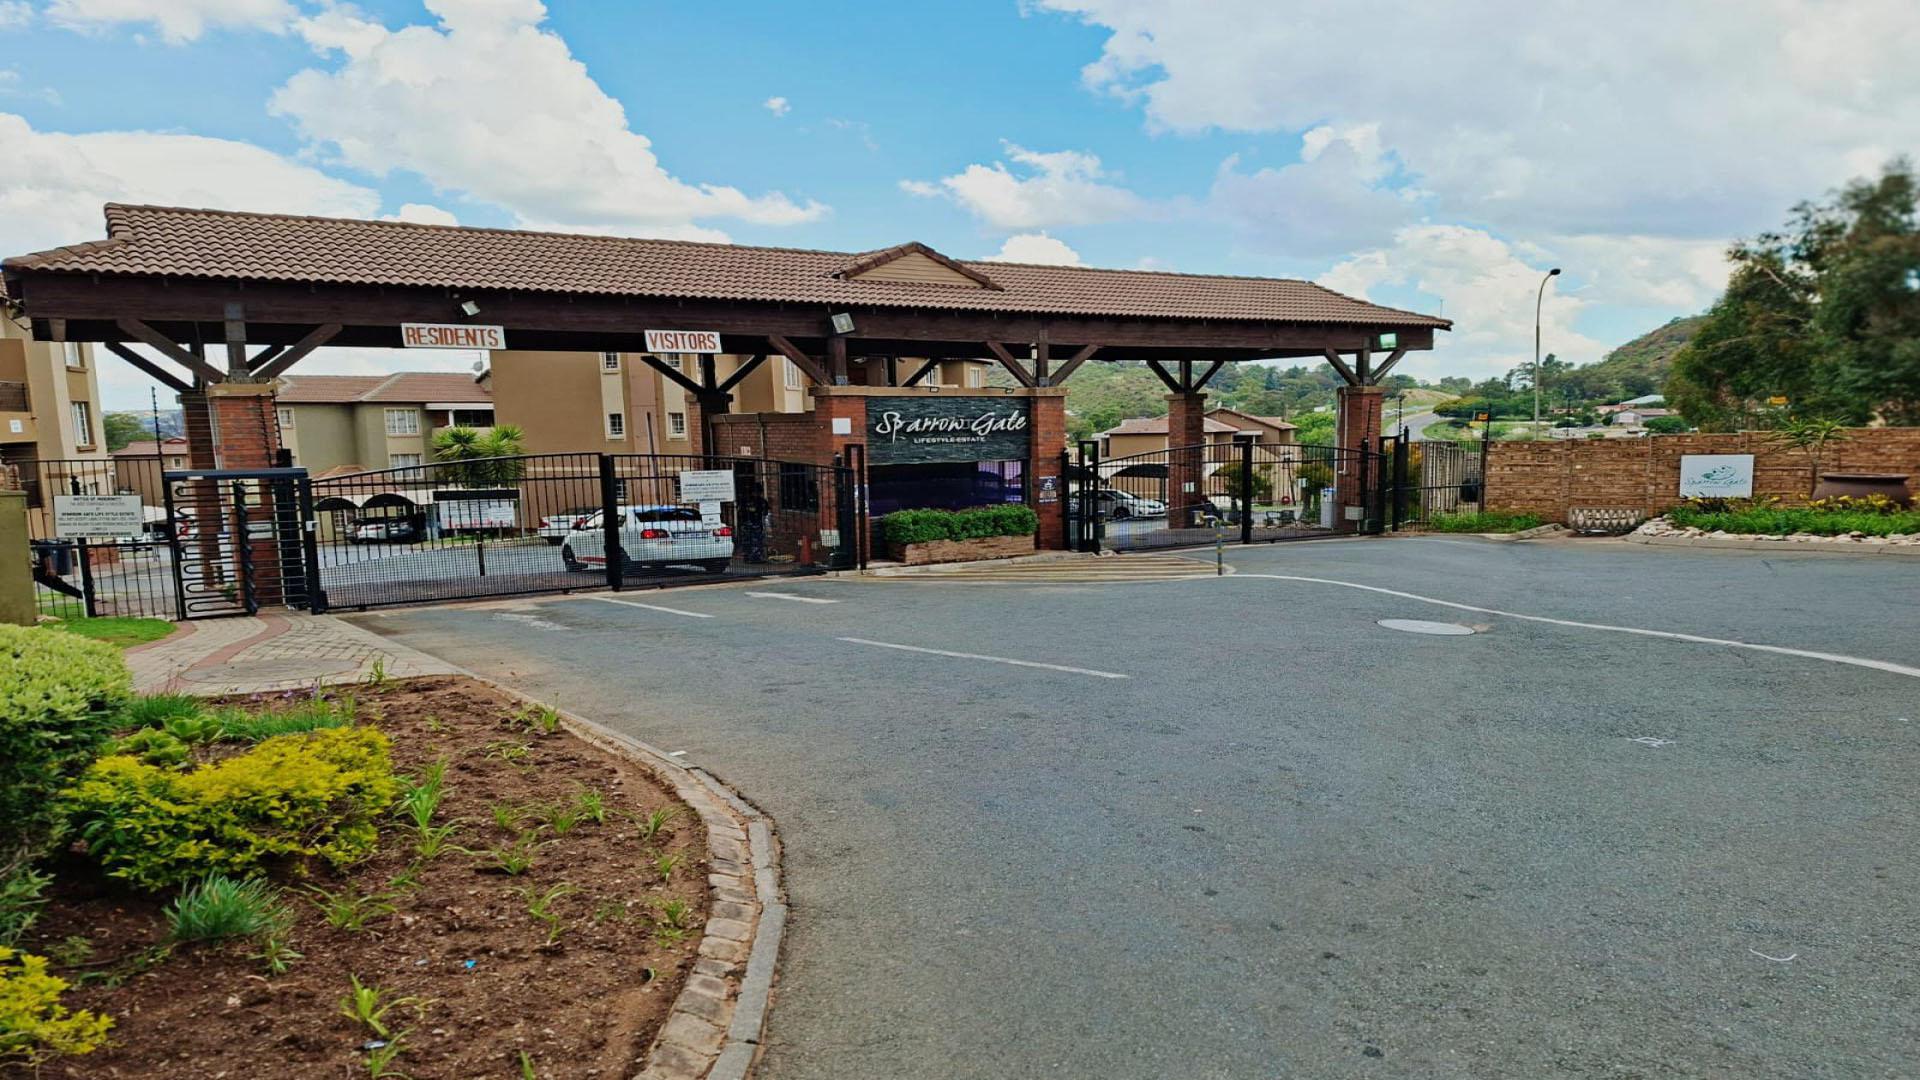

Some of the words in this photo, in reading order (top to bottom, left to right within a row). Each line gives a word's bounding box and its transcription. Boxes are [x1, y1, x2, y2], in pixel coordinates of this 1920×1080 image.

[404, 326, 499, 347] RESIDENTS
[647, 332, 717, 350] VISITORS
[875, 411, 964, 445] Sparrow
[971, 409, 1027, 436] Gate
[913, 436, 955, 444] LIFESTYLE
